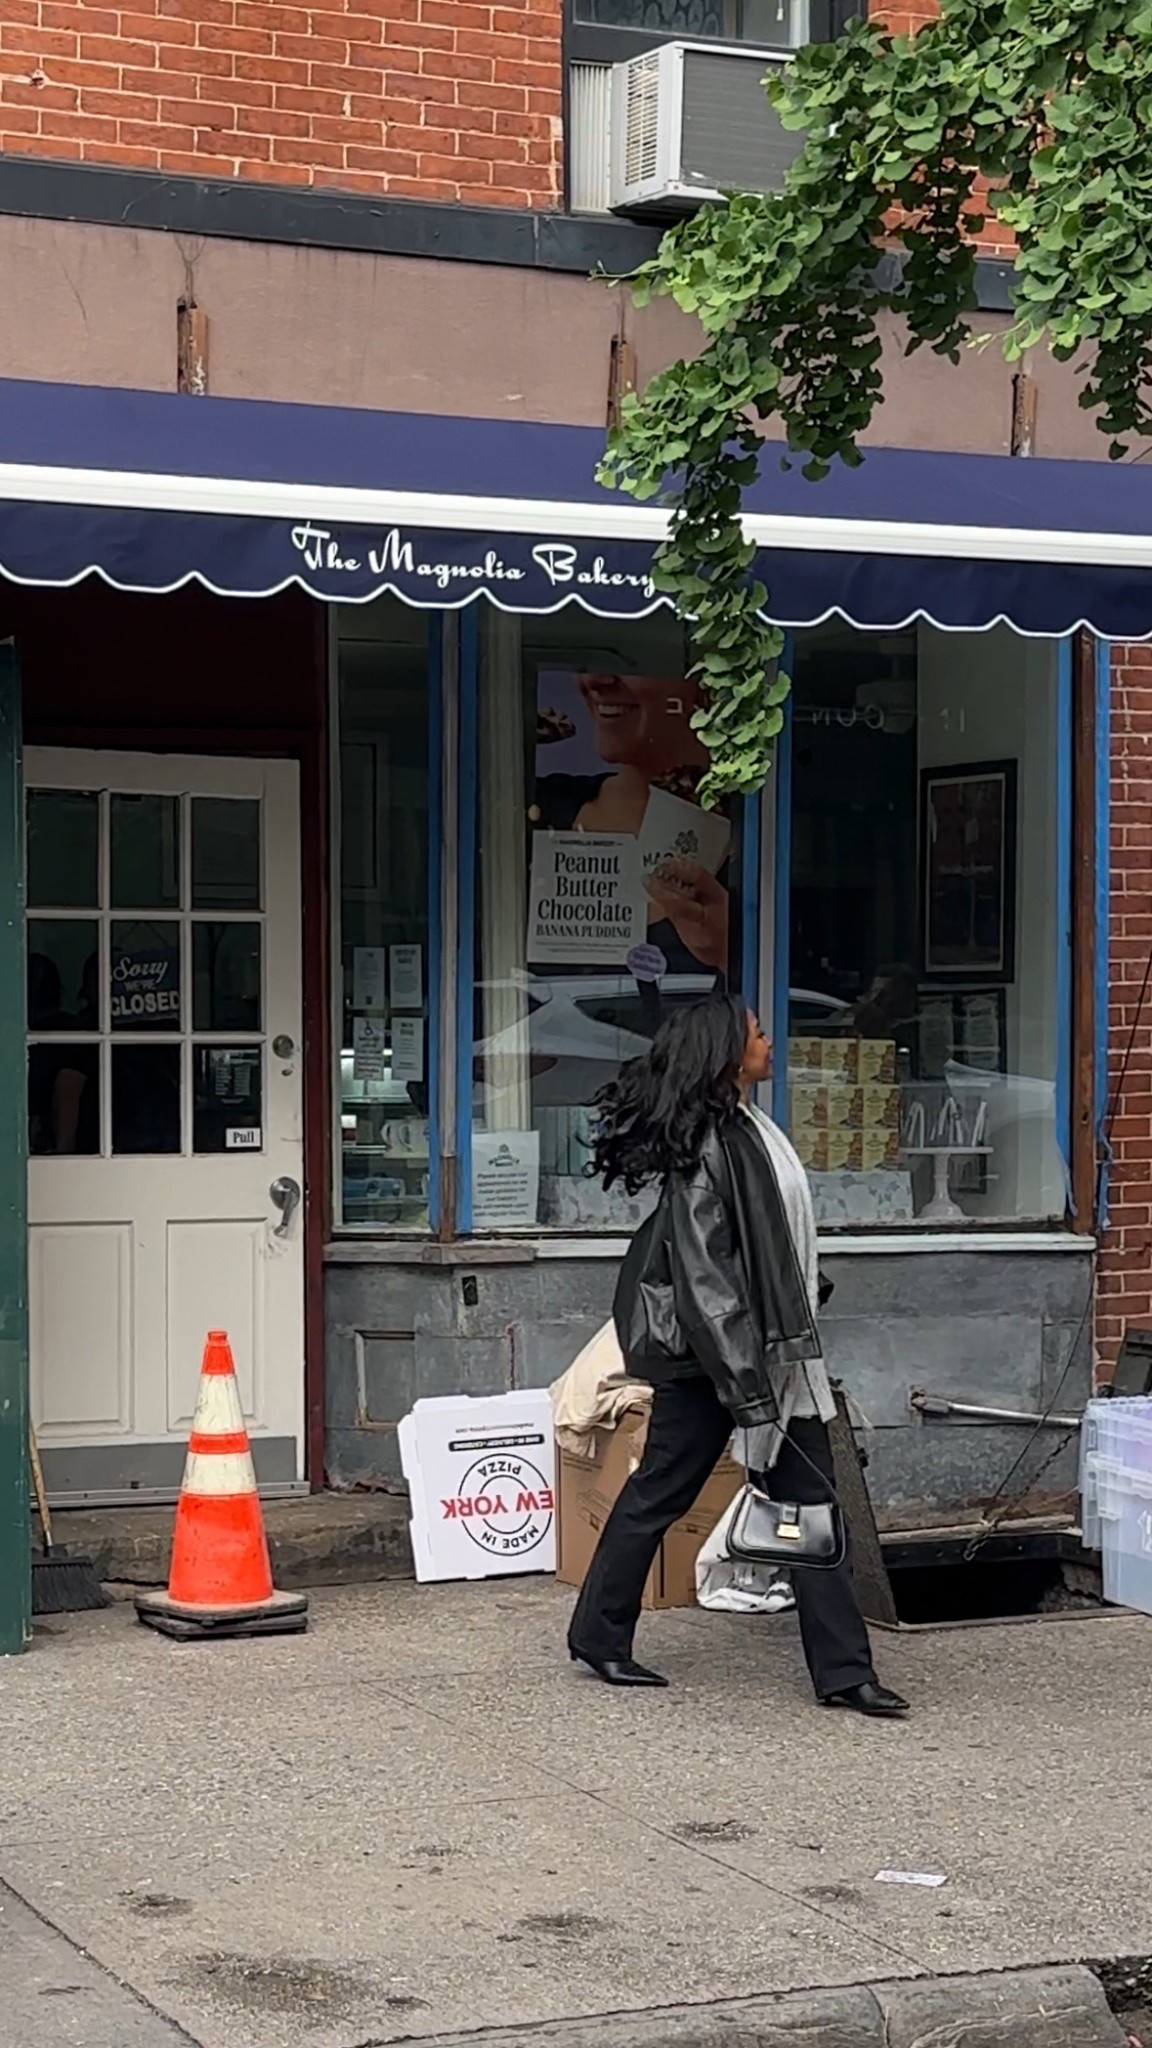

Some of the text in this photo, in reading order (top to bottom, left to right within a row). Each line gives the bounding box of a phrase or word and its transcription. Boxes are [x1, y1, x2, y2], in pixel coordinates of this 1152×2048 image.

[291, 521, 655, 598] The Magnolia Bakery
[554, 852, 620, 875] Peanut
[556, 876, 618, 898] Butter
[538, 899, 632, 922] Chocolate
[536, 924, 631, 938] BANANA PUDDING
[113, 957, 168, 983] Sorry
[111, 990, 180, 1016] CLOSED
[233, 1131, 254, 1143] Pull
[477, 1461, 522, 1477] PIZZA
[440, 1490, 554, 1519] EW YORK
[481, 1525, 539, 1549] MADE IN
